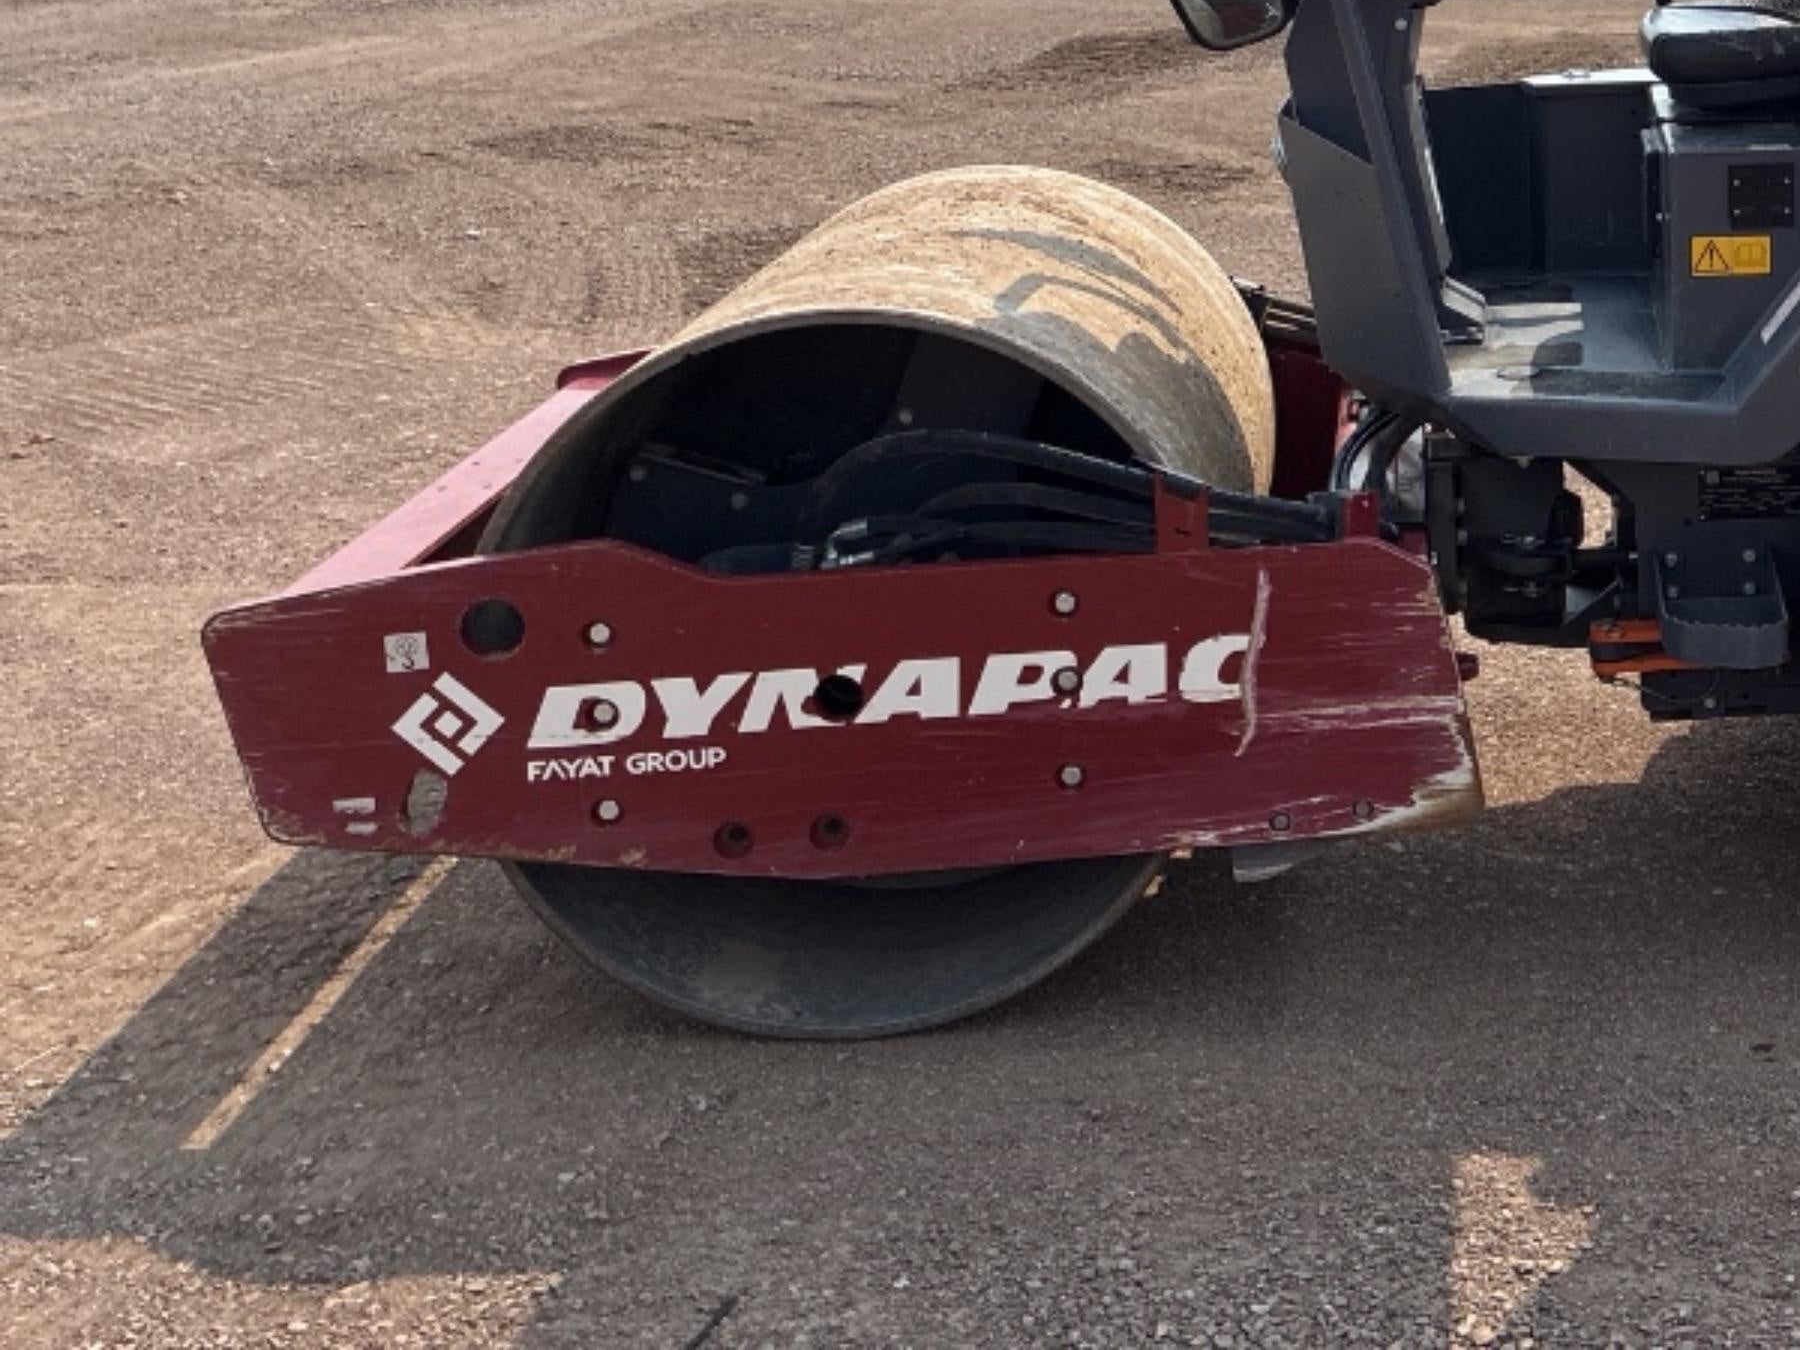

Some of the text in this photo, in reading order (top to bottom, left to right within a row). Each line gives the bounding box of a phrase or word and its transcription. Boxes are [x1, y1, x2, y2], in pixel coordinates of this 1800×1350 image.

[527, 634, 1261, 749] DYNAPAC
[527, 747, 727, 783] FAYAT GROUP
